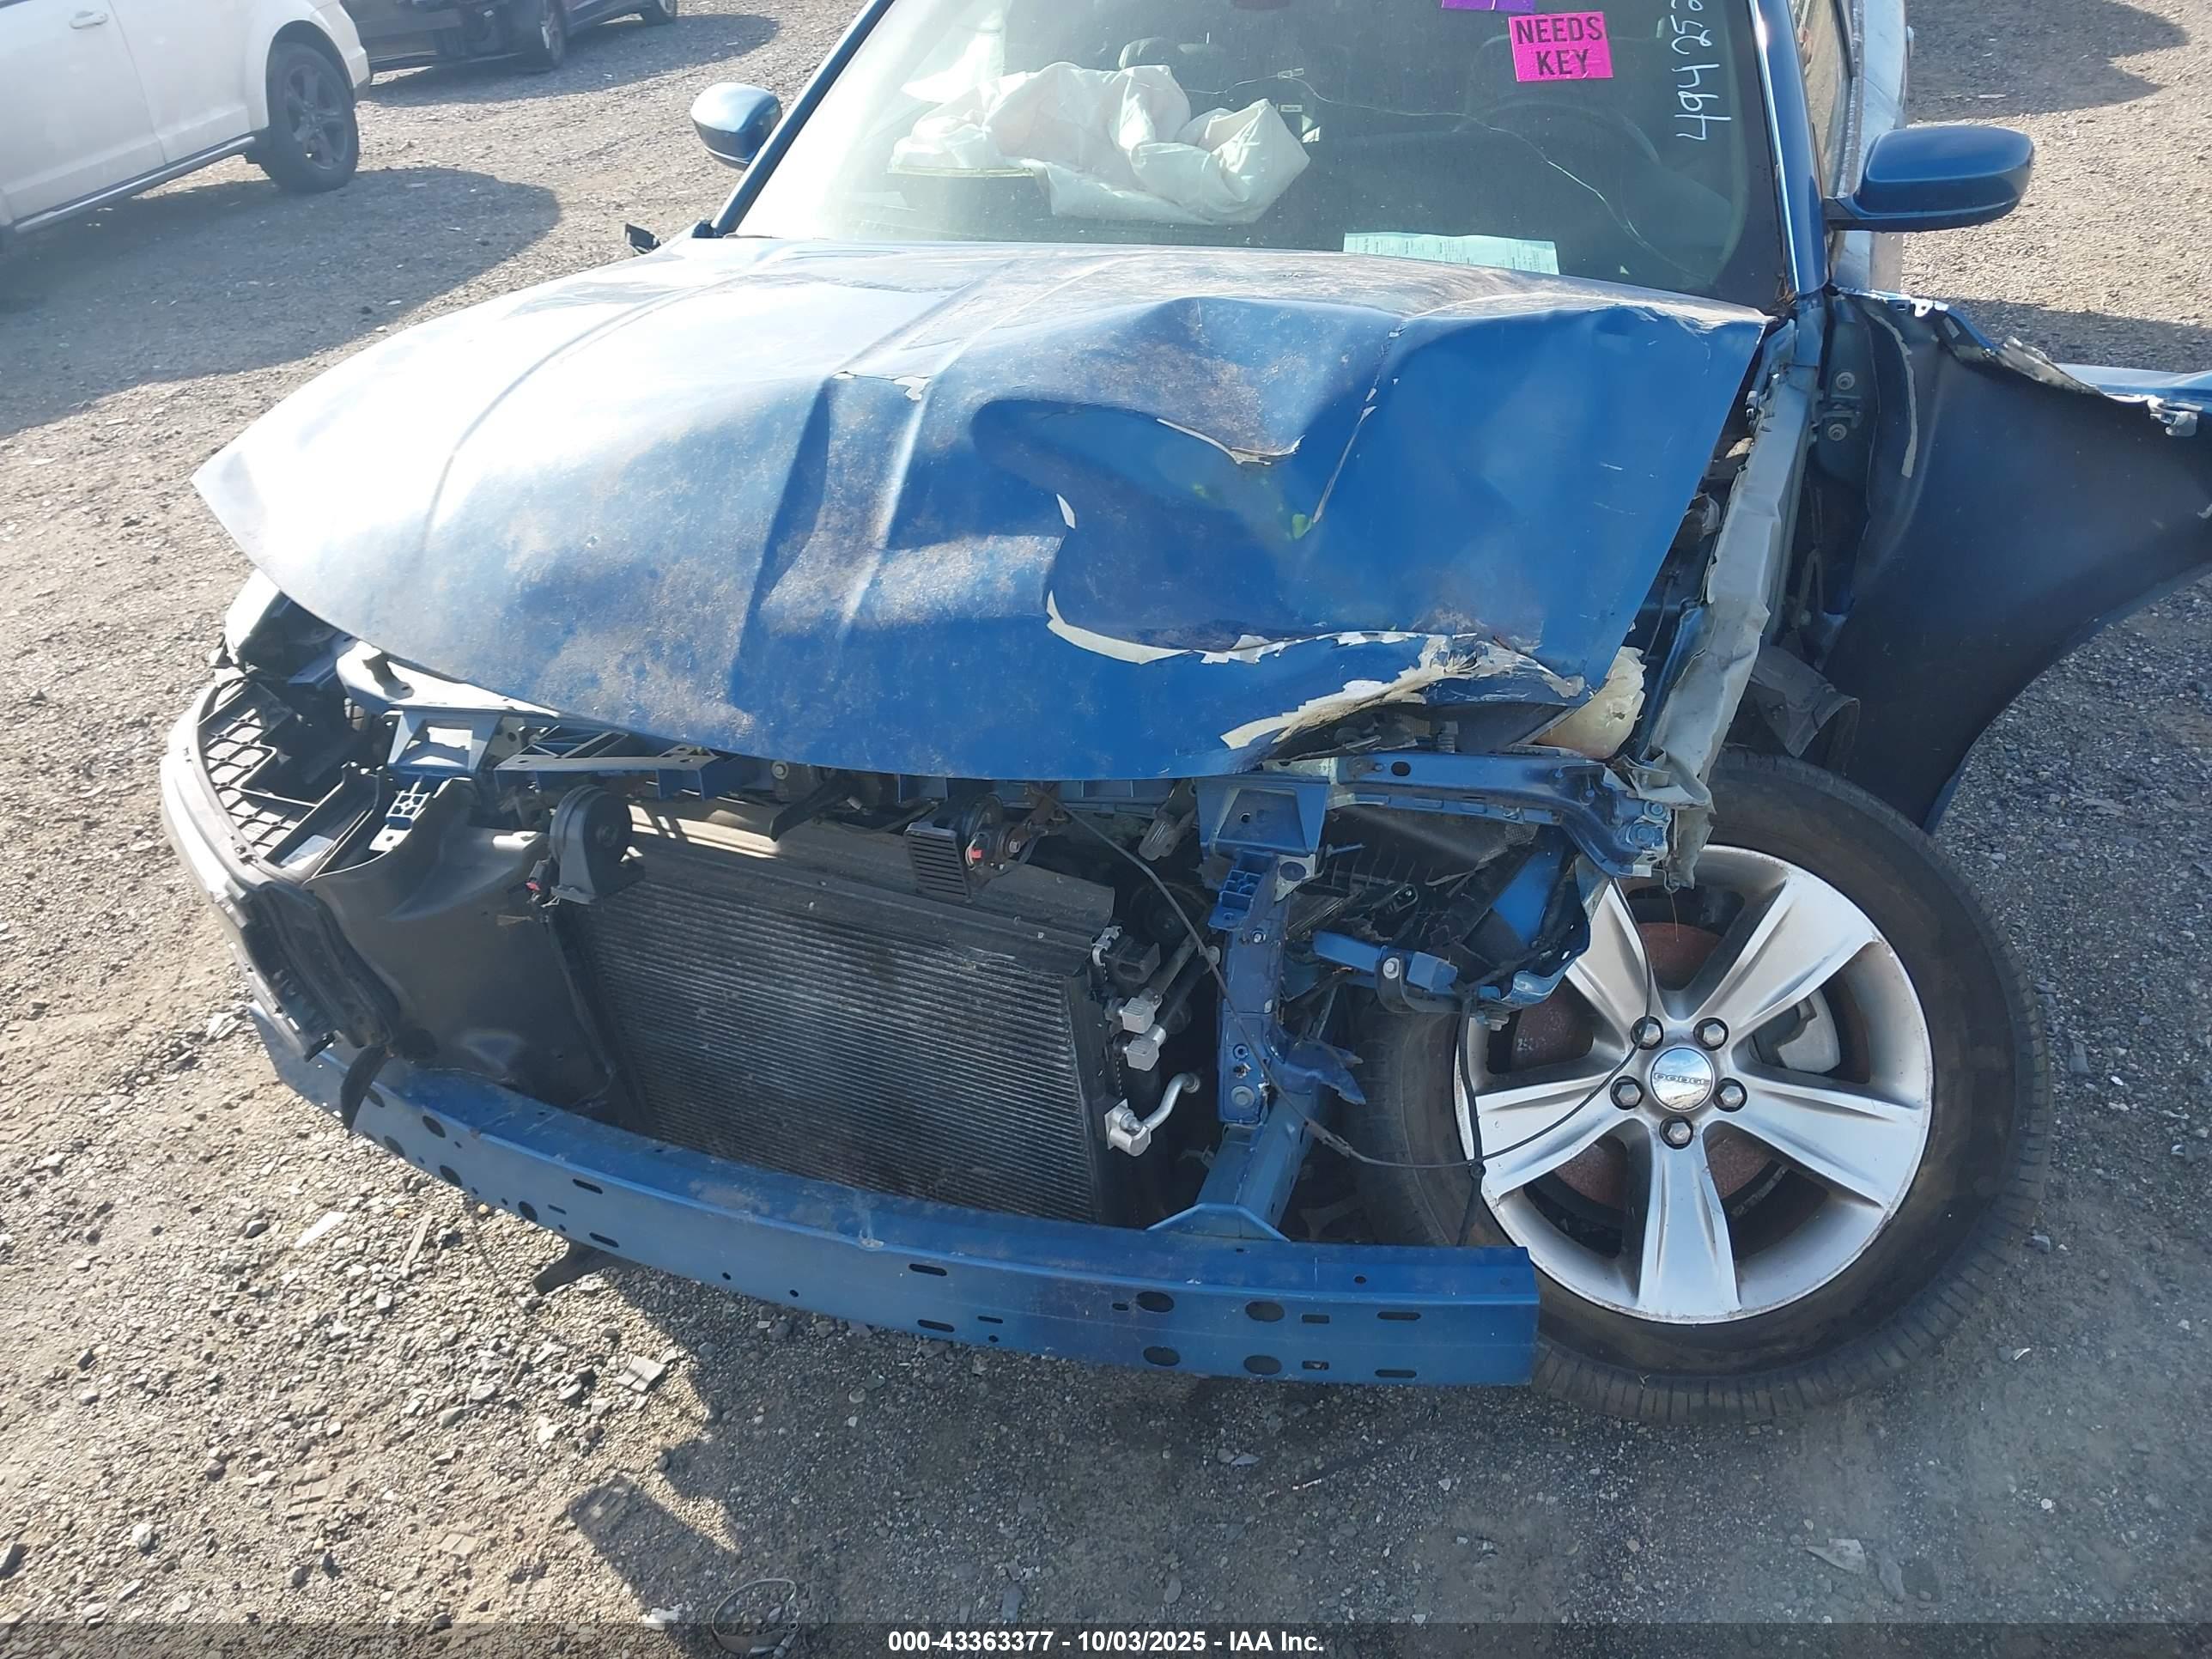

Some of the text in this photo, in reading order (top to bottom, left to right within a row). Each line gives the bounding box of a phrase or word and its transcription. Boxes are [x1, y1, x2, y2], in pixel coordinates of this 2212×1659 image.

[1516, 16, 1603, 45] NEEDS
[1536, 48, 1589, 76] KEY
[1654, 1072, 1711, 1085] DODGE
